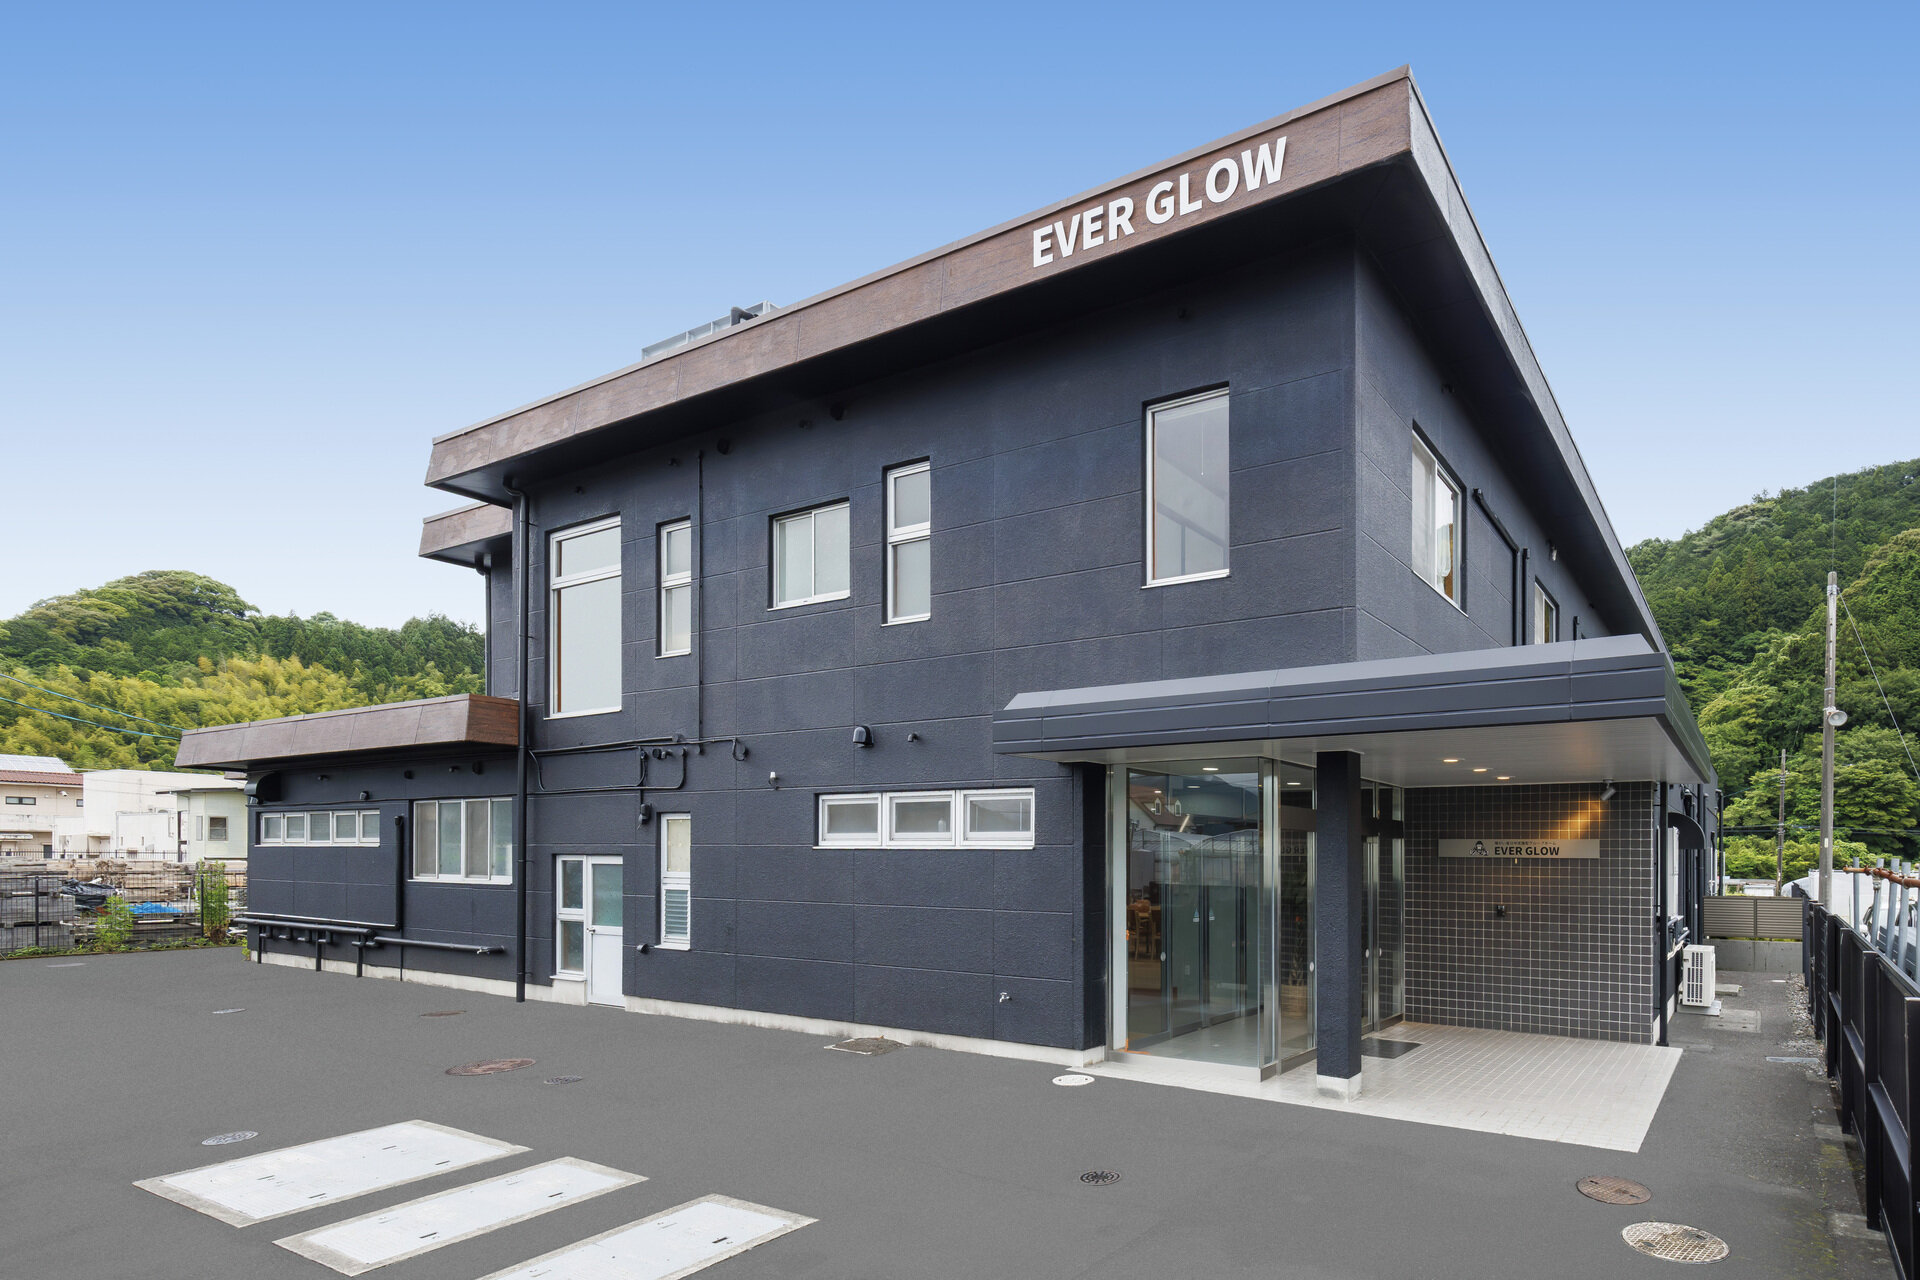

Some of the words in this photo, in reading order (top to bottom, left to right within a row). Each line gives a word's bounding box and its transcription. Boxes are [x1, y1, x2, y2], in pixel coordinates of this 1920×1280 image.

[1032, 196, 1136, 268] EVER
[1145, 135, 1288, 225] GLOW
[1494, 846, 1523, 856] EVER
[1525, 846, 1560, 856] GLOW
